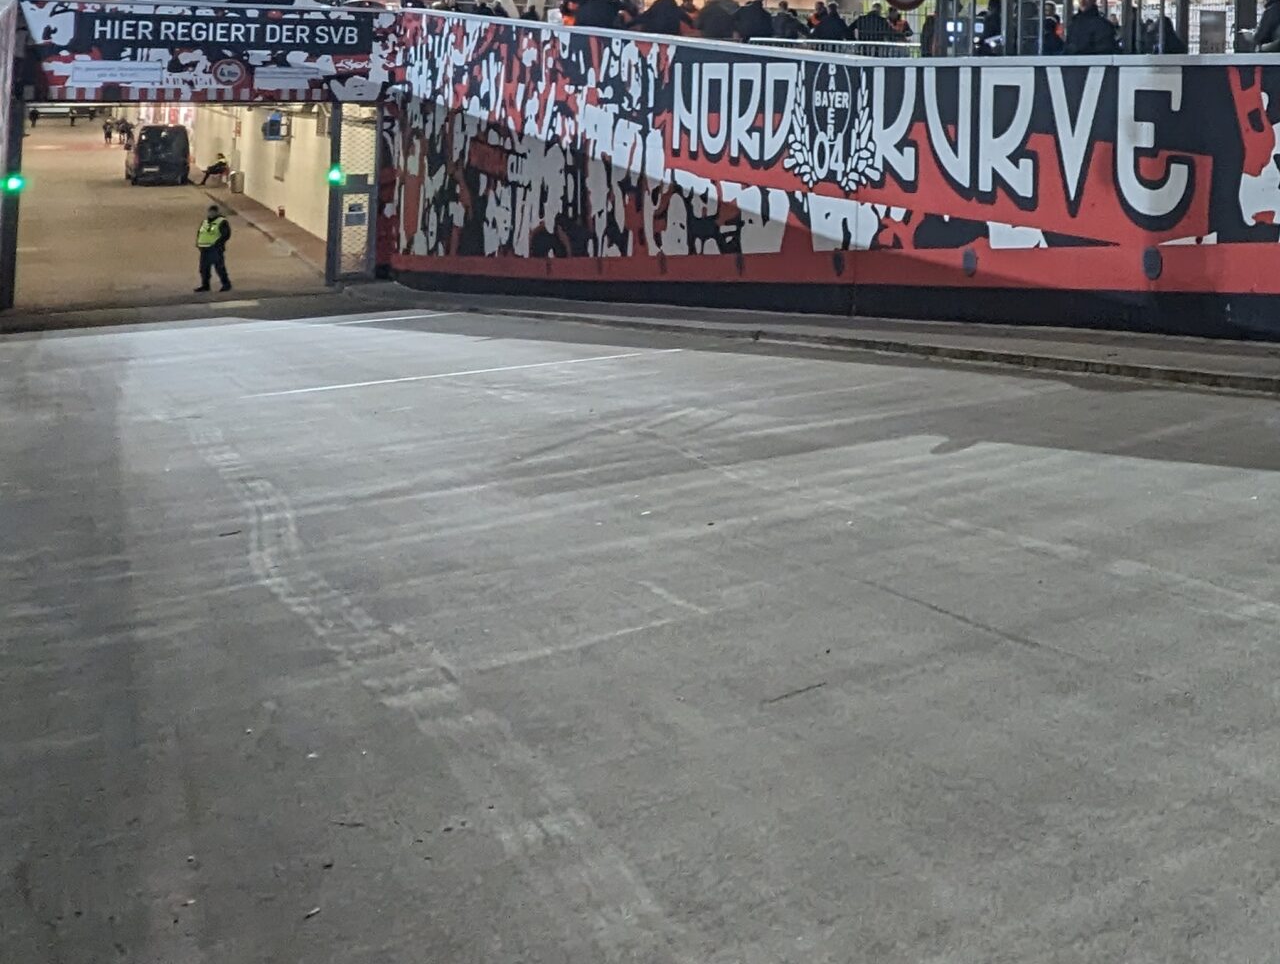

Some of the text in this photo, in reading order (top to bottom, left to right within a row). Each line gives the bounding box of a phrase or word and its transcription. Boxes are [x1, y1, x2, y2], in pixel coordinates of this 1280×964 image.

[94, 20, 359, 45] HIER REGIERT DER SVB
[814, 90, 849, 109] BAYER
[672, 62, 1189, 217] NORD KURVE
[813, 131, 845, 182] 04
